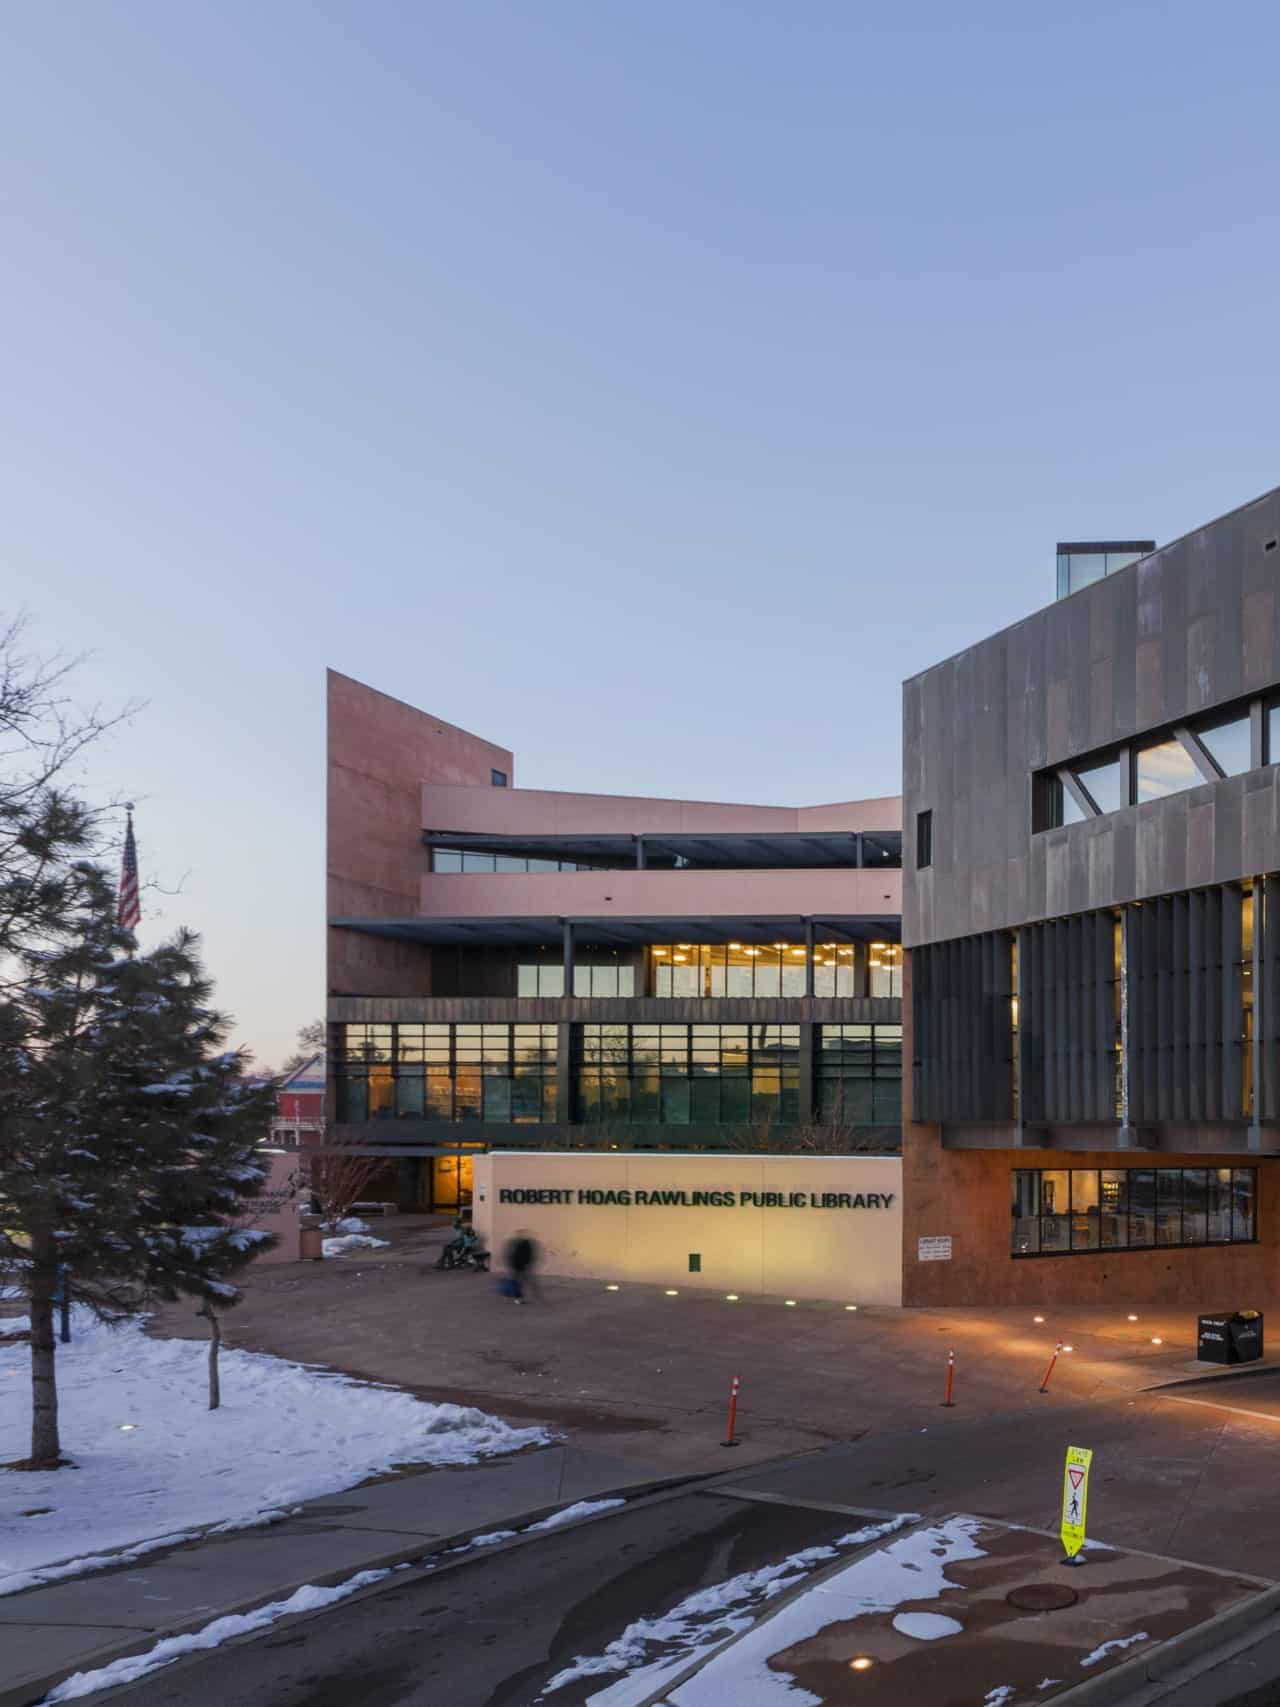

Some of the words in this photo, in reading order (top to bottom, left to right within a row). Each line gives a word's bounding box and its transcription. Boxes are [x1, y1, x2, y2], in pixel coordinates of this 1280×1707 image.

[499, 1188, 574, 1205] ROBERT
[577, 1189, 632, 1206] HOAG
[634, 1190, 736, 1208] RAWLINGS
[739, 1191, 808, 1208] PUBLIC
[810, 1192, 894, 1209] LIBRARY
